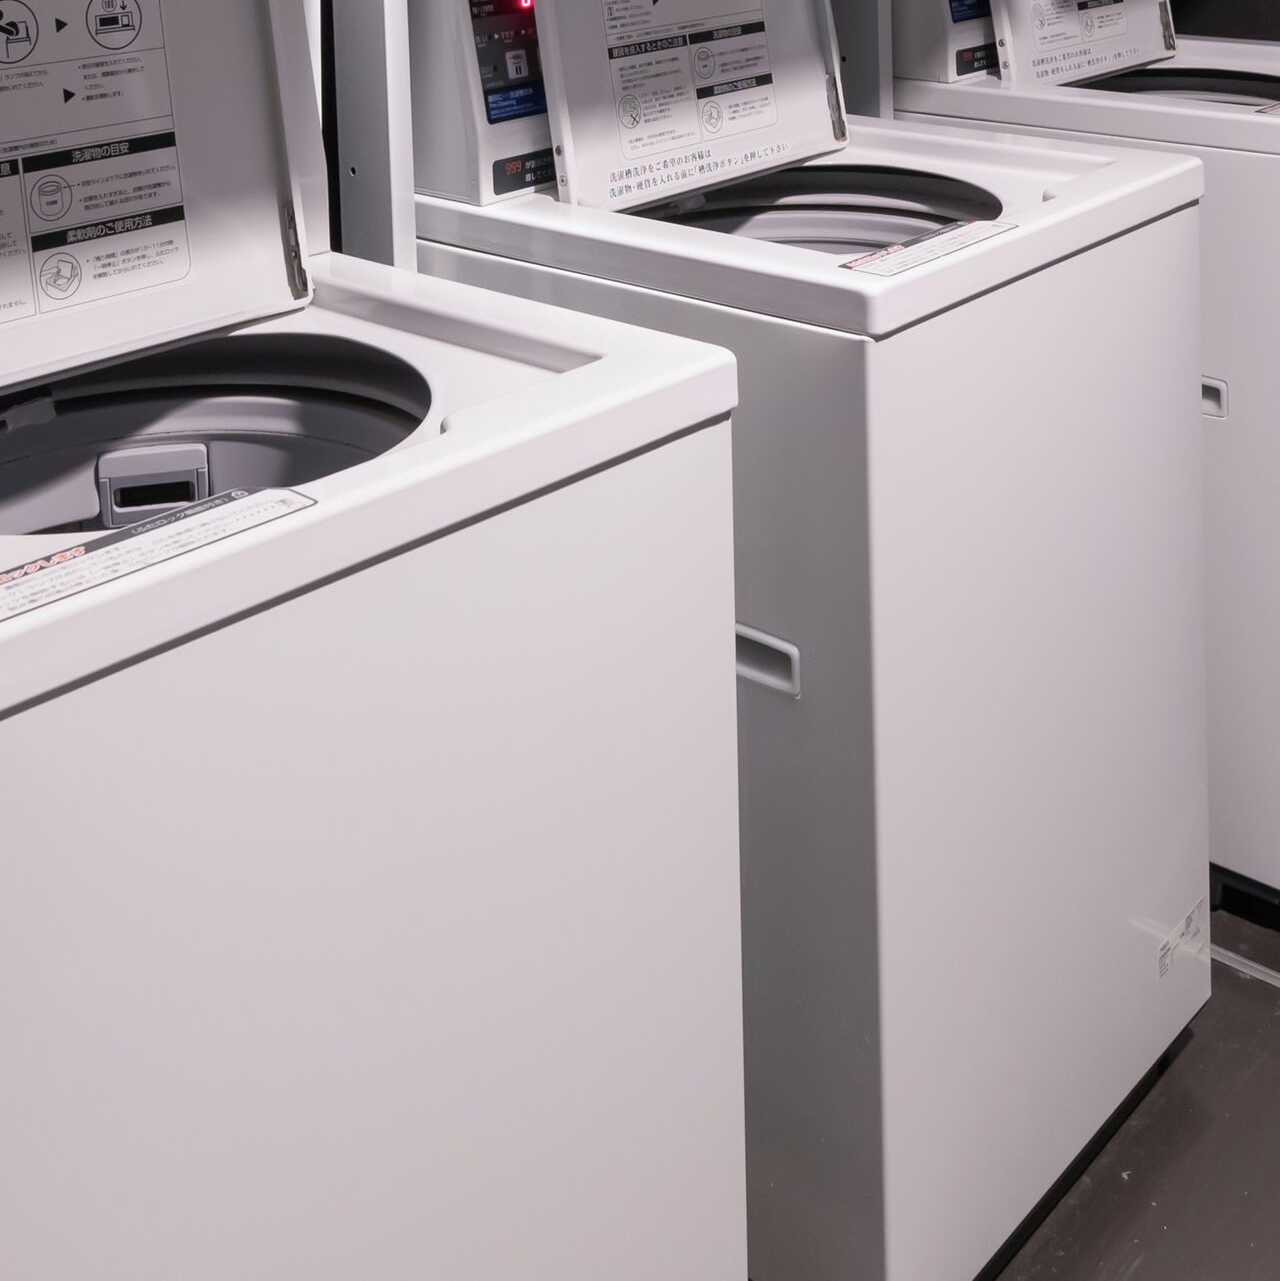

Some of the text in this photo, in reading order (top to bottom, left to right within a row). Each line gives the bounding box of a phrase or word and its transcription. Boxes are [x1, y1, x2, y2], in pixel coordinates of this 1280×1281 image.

[72, 141, 130, 164] 洗濯物の目安
